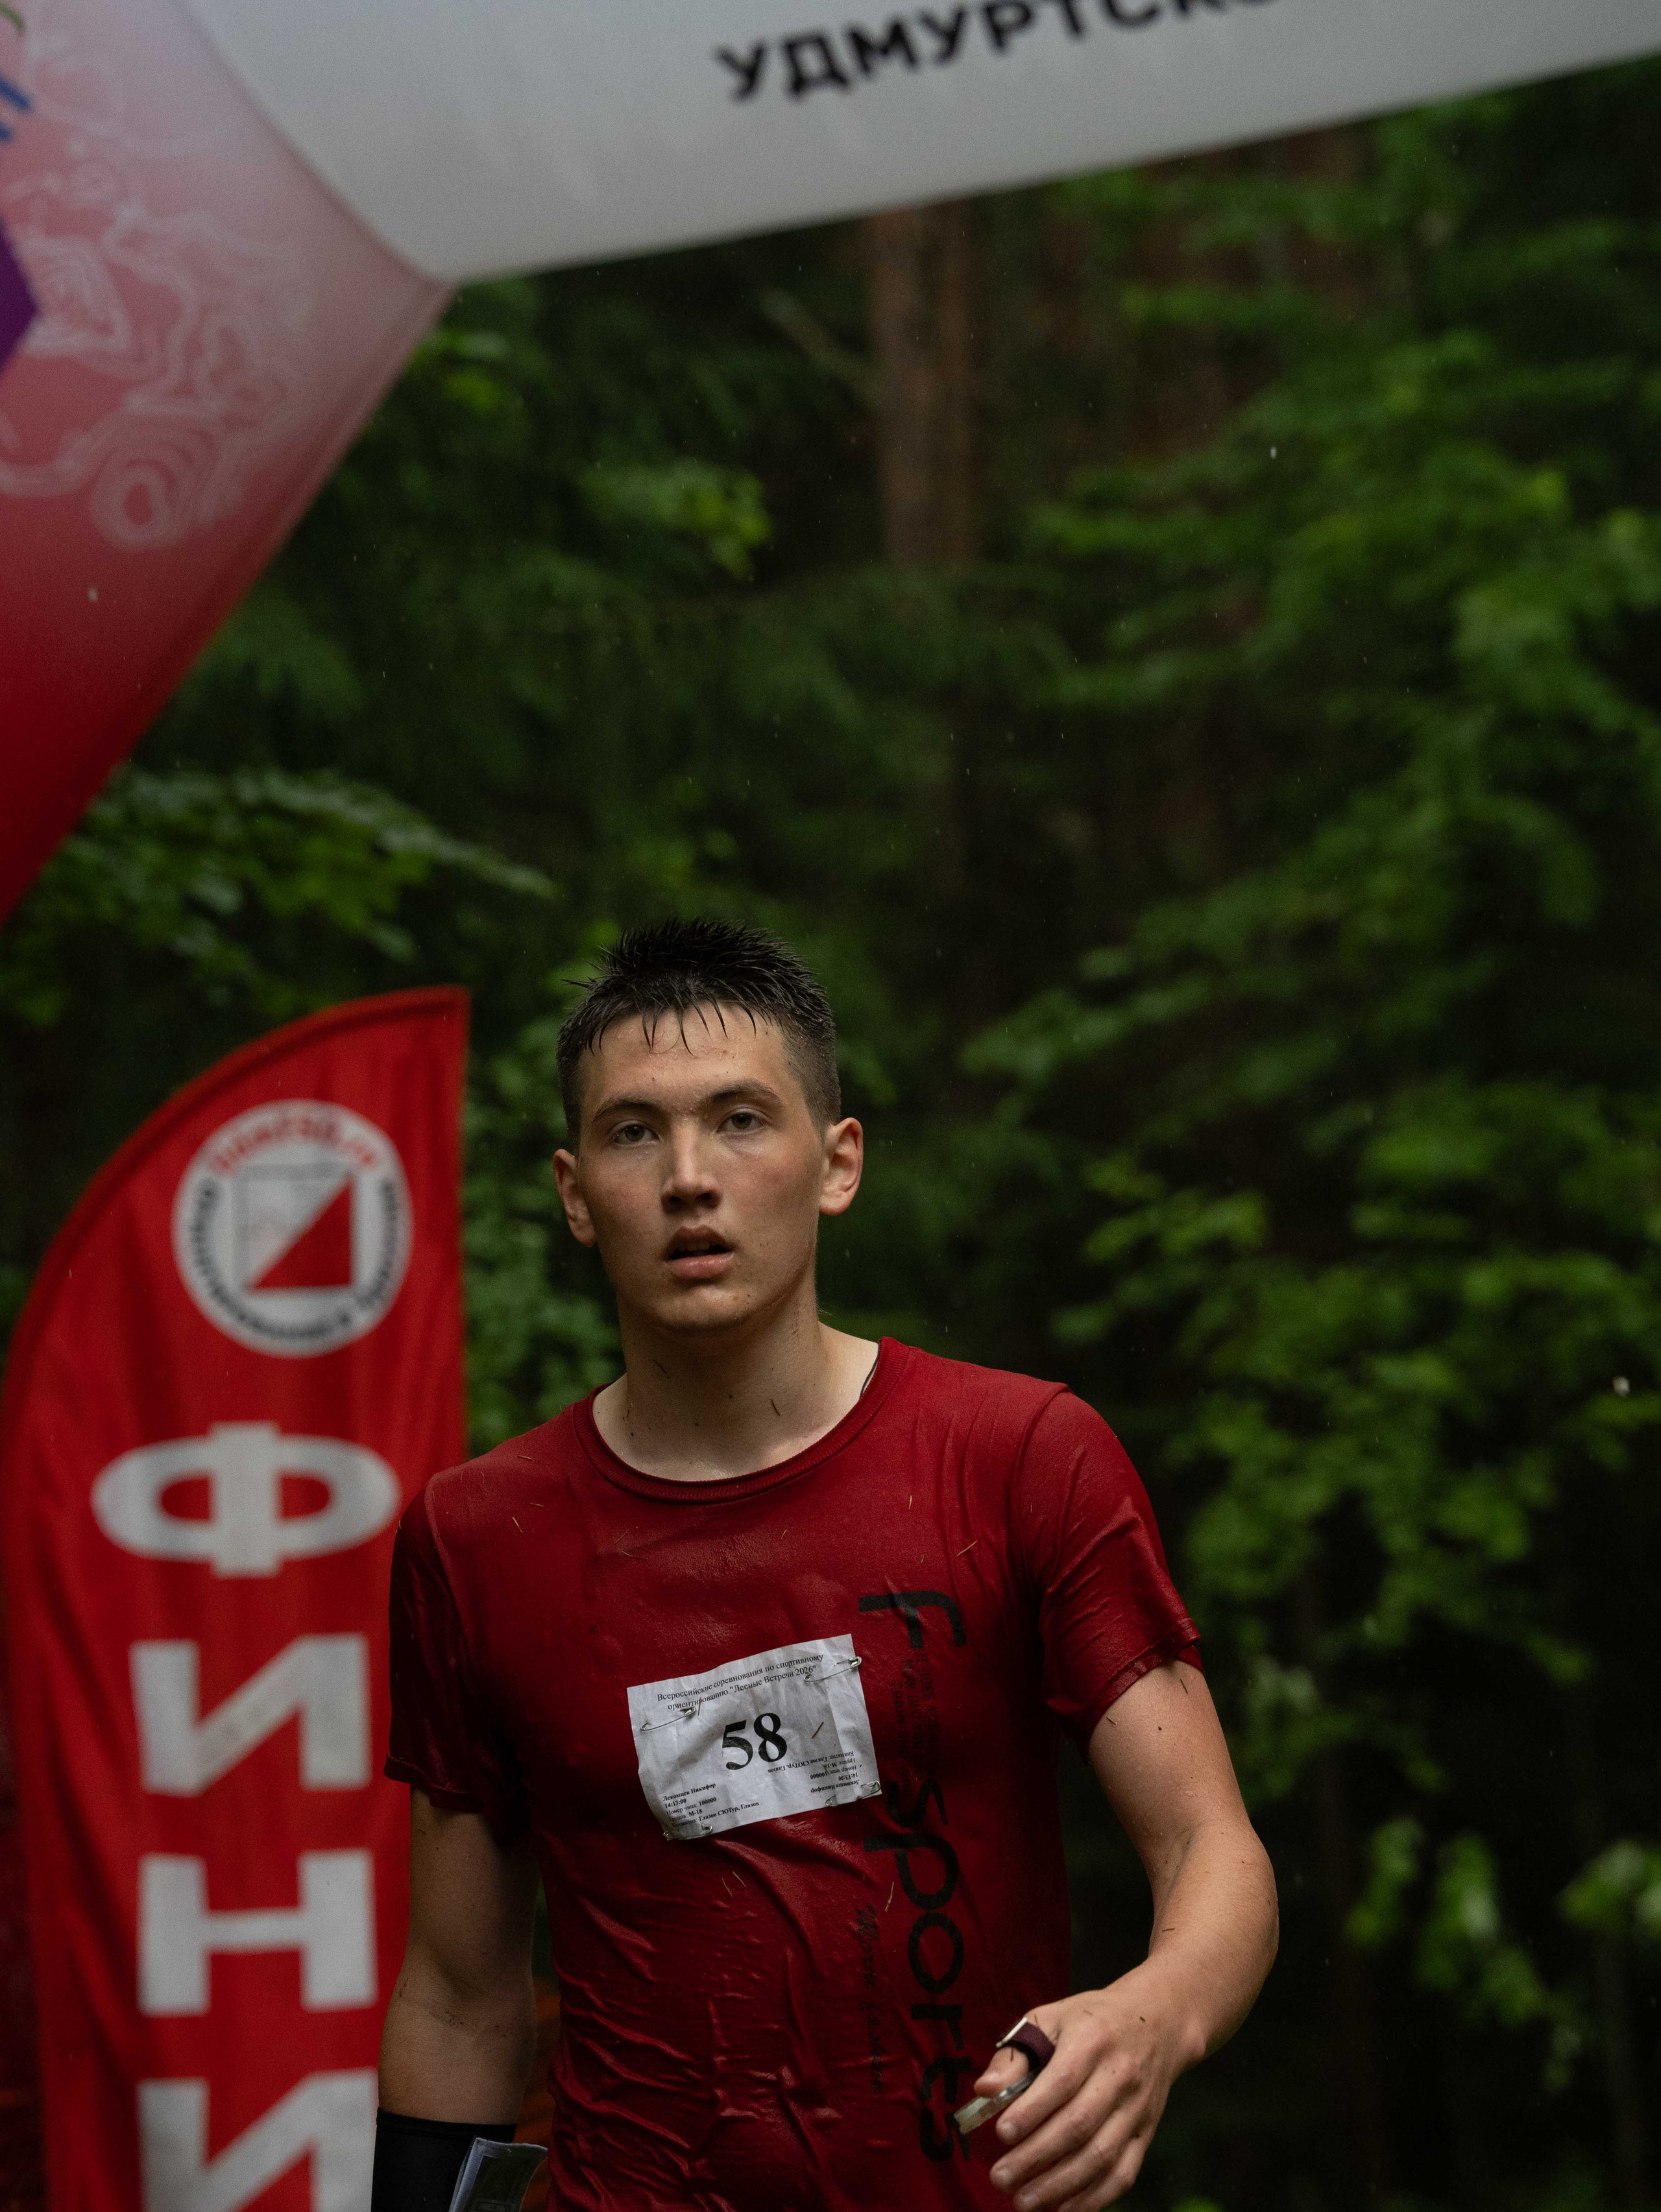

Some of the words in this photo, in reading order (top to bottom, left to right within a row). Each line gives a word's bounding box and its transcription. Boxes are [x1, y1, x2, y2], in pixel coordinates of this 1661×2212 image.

[657, 1683, 712, 1702] Всероссийские
[714, 1668, 764, 1690] соревнования
[764, 1664, 775, 1673] по
[776, 1654, 824, 1670] спортивному
[667, 1689, 729, 1711] ориентированию
[730, 1679, 764, 1694] "Лесные
[764, 1671, 794, 1685] Встречи
[722, 1713, 787, 1770] 58
[838, 1772, 858, 1781] 14:13:00
[662, 1791, 690, 1801] Лекомцев
[690, 1783, 716, 1793] Никифор
[664, 1798, 686, 1809] 14:13:00
[699, 1797, 717, 1806] 100000
[688, 1809, 703, 1817] М-18
[698, 1812, 717, 1821] Глазов
[717, 1806, 740, 1816] СЮТур,
[740, 1801, 760, 1809] Глазов
